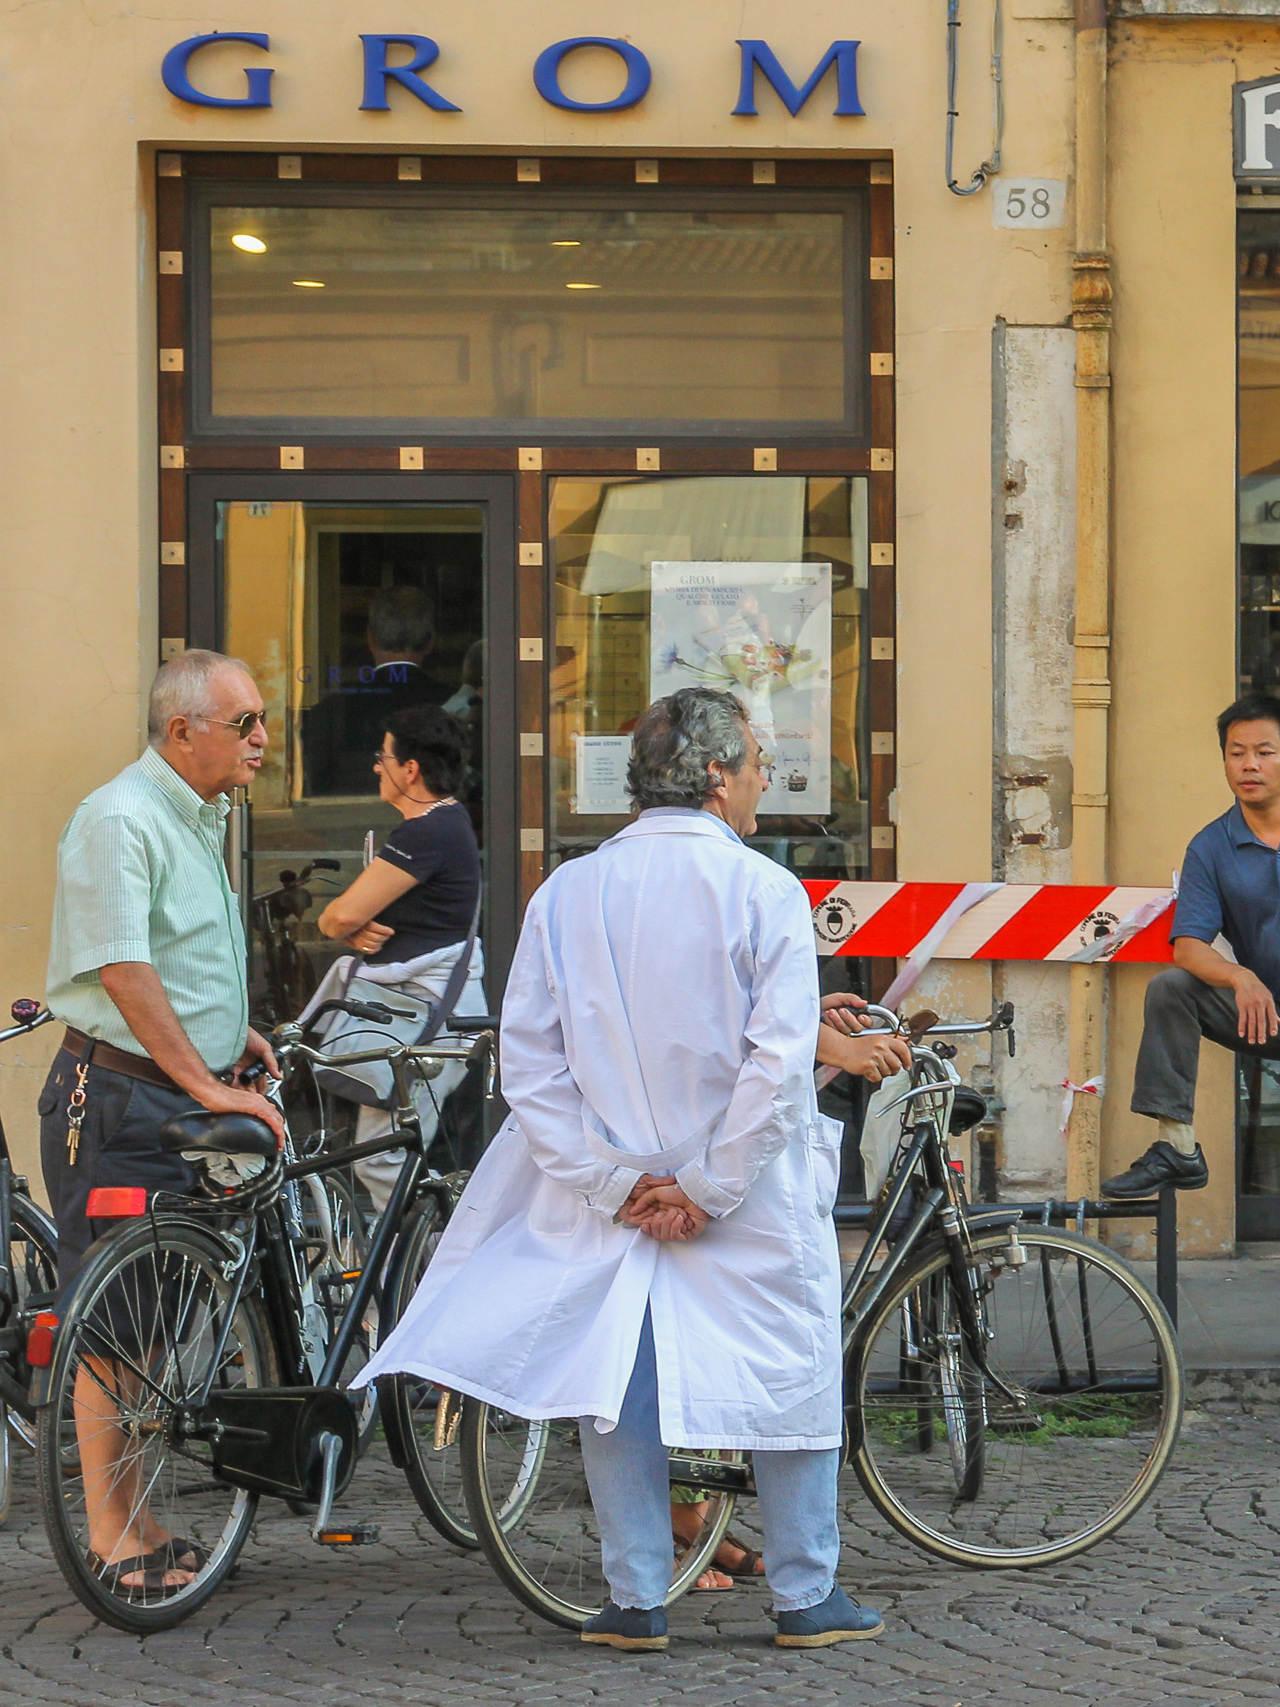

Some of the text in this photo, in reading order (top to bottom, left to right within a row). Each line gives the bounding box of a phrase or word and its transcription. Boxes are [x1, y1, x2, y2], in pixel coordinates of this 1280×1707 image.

[160, 30, 867, 118] GROM
[1004, 186, 1052, 220] 58
[680, 575, 715, 585] GROM
[296, 665, 408, 684] GROM
